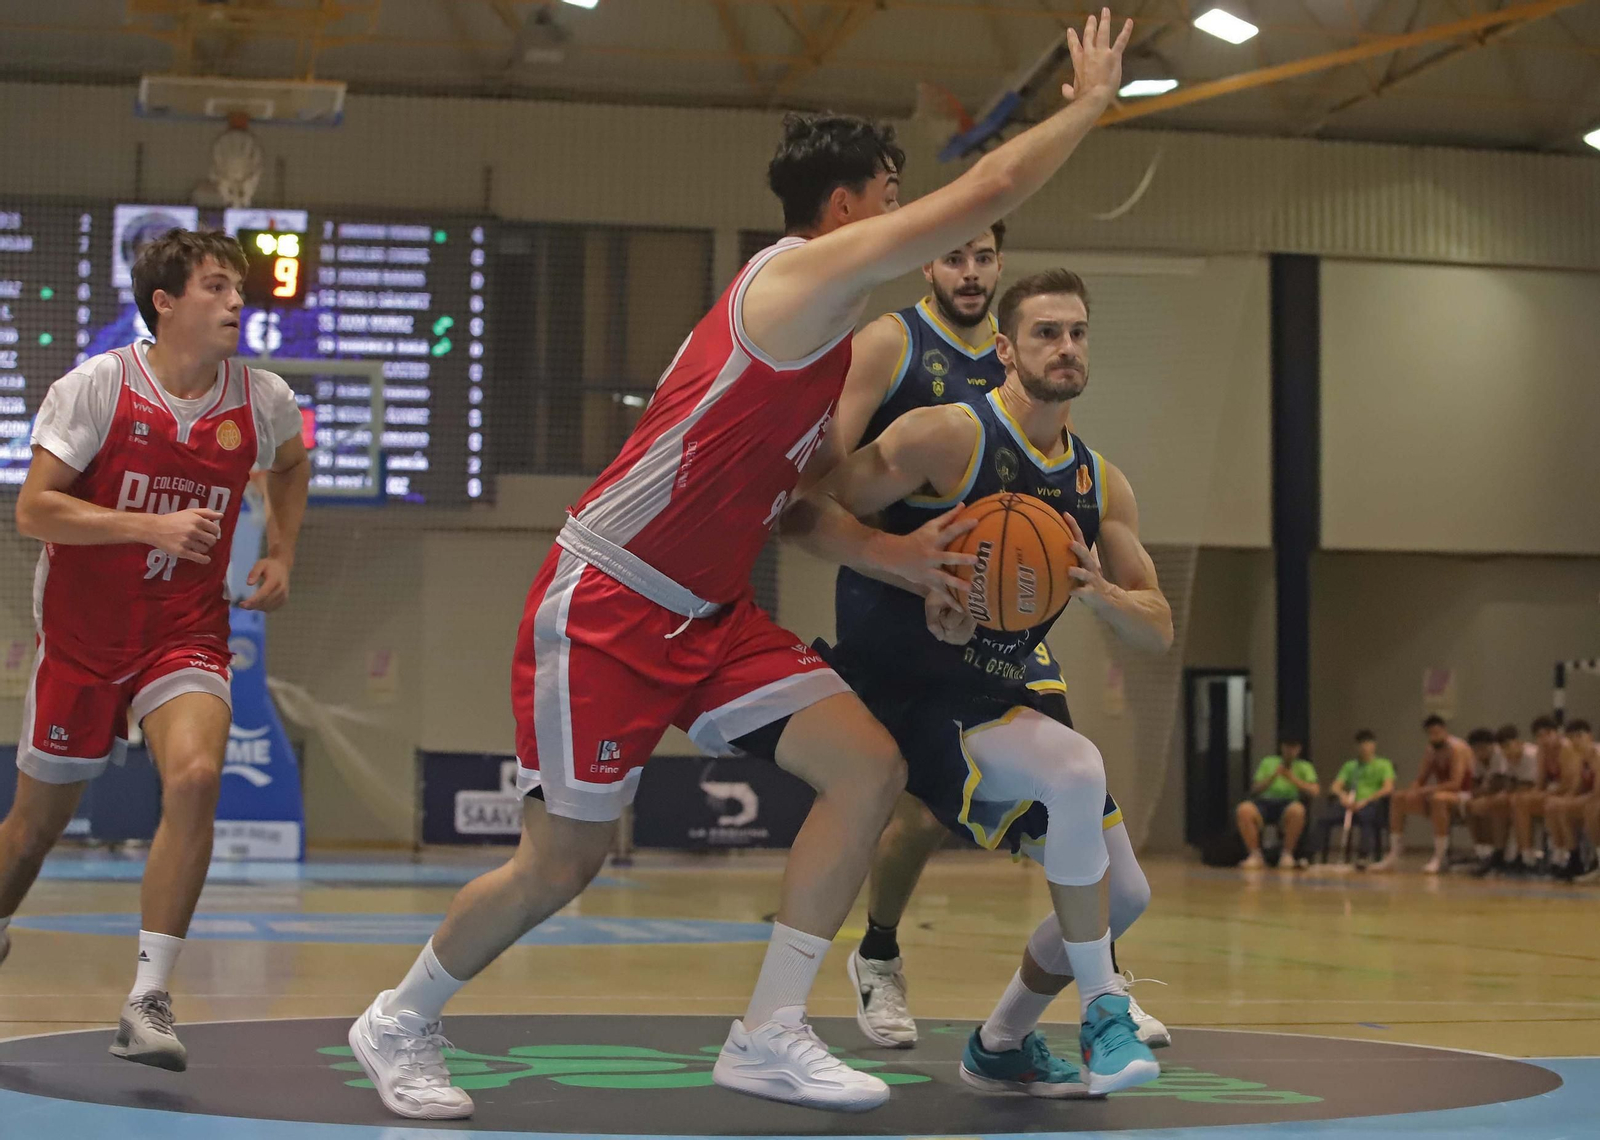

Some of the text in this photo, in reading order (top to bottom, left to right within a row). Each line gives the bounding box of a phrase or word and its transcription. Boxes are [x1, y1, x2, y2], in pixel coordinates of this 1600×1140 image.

[273, 257, 299, 297] 9
[965, 377, 987, 387] vive
[153, 475, 208, 498] COLEGIO EL
[1037, 486, 1062, 498] vive
[143, 549, 178, 582] 91
[967, 541, 994, 622] Wilson
[190, 659, 220, 671] vive
[599, 765, 619, 774] Pina
[463, 804, 522, 827] SAAV
